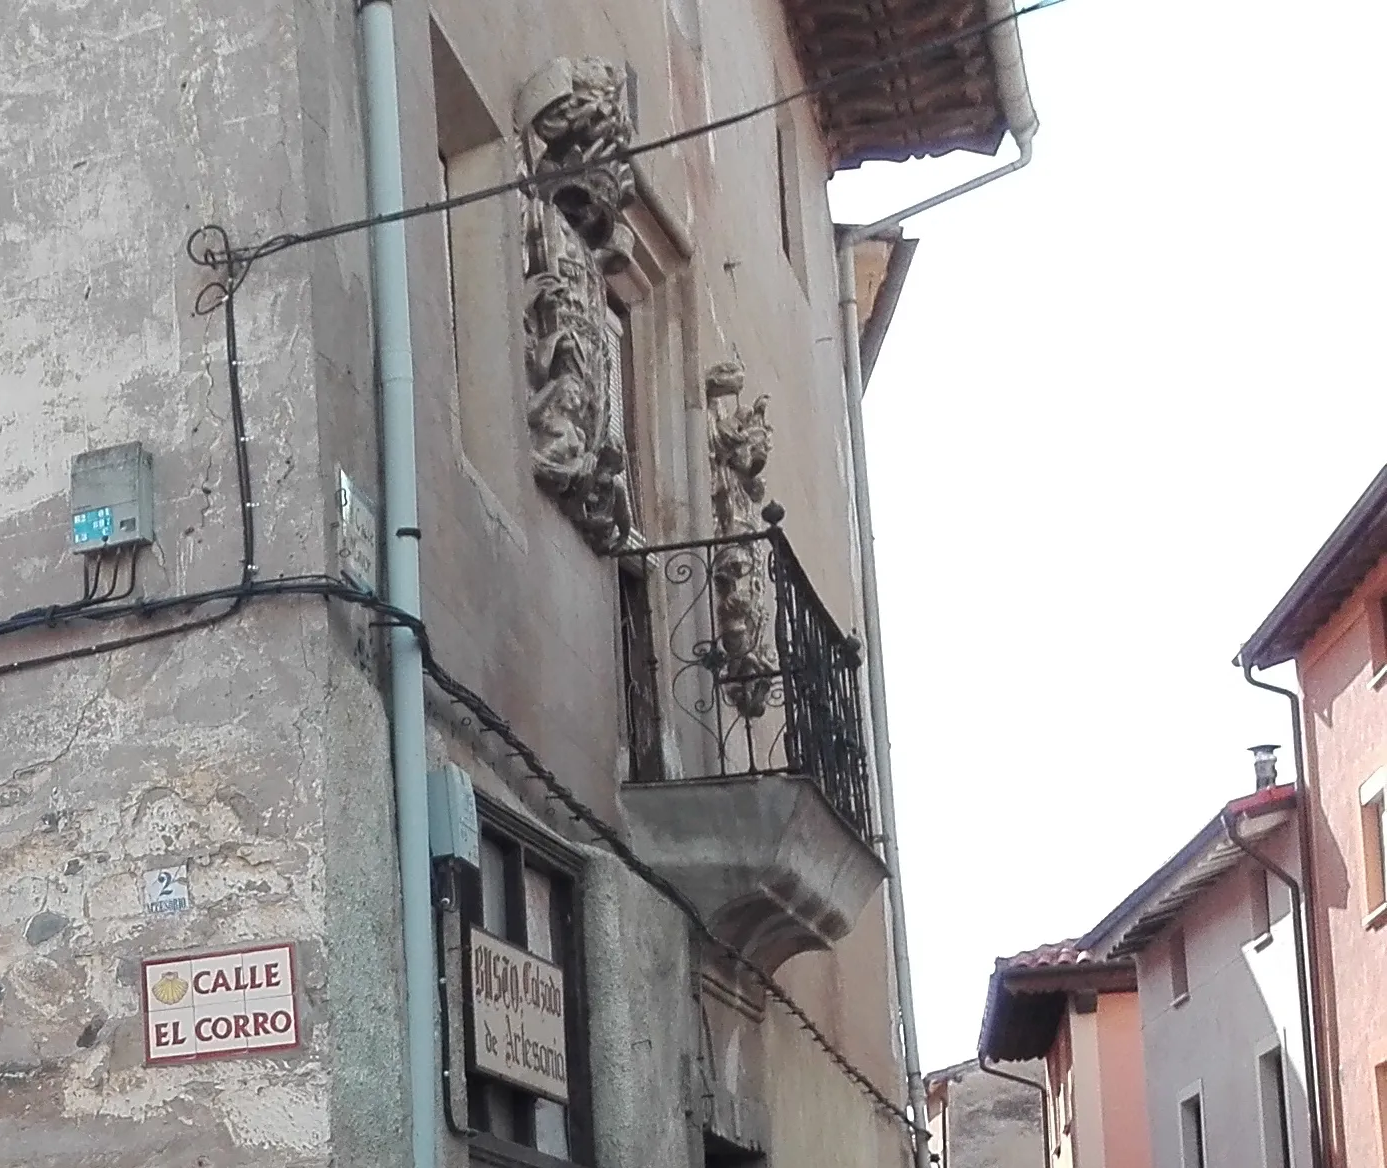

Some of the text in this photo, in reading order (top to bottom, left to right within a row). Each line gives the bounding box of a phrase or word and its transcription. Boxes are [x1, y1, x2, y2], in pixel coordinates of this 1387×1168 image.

[157, 871, 174, 897] 2
[193, 962, 282, 995] CALLE
[154, 1010, 293, 1048] EL CORRO
[483, 1020, 499, 1057] de
